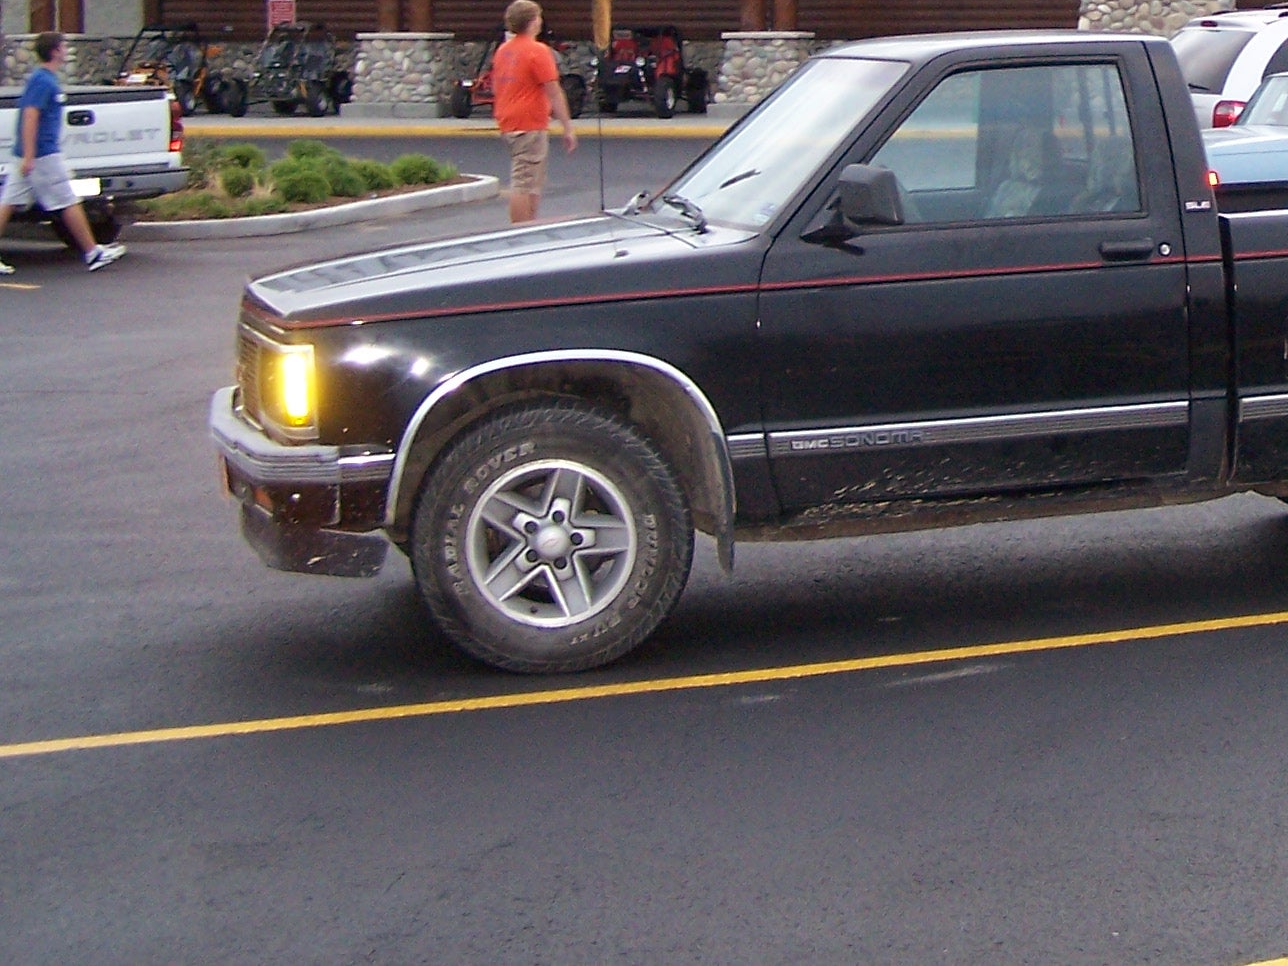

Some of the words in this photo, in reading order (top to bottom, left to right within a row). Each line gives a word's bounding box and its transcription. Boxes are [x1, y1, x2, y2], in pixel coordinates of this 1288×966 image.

[790, 439, 829, 450] GMC
[830, 431, 923, 447] SONOMA
[464, 442, 535, 494] ROVER
